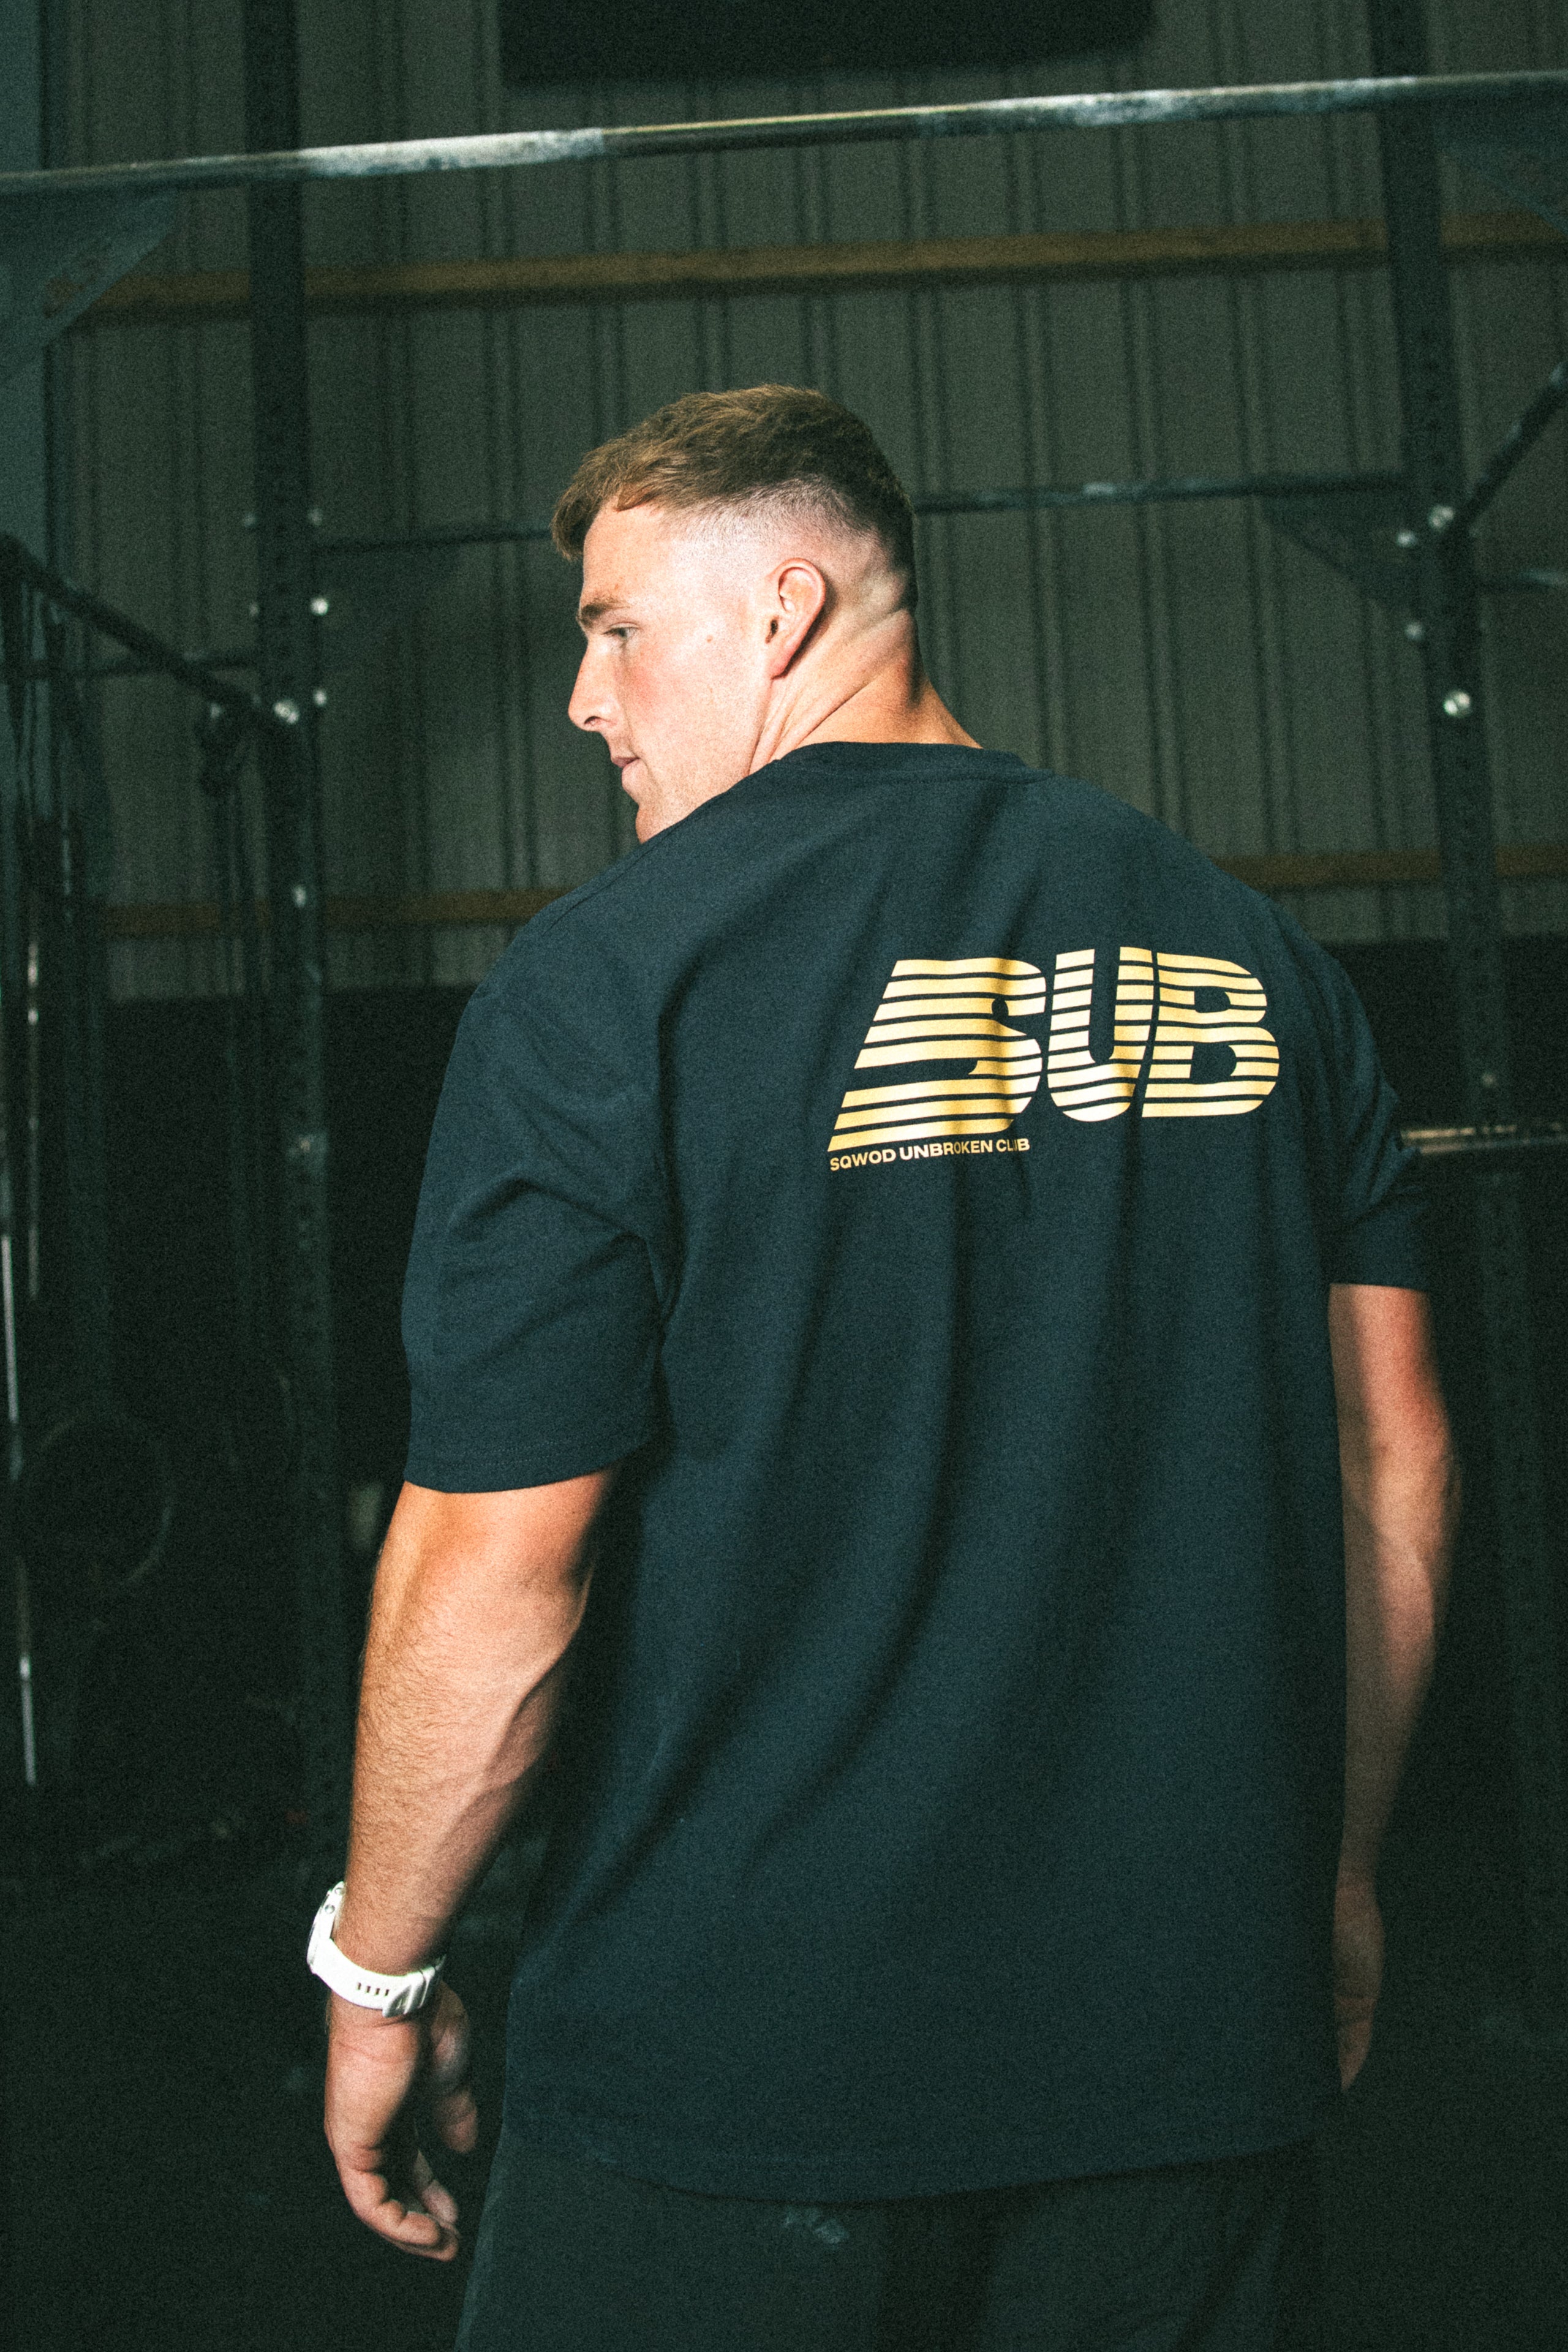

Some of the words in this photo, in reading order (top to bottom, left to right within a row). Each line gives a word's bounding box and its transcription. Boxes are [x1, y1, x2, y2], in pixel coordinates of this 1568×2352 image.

[827, 946, 1279, 1152] SUB
[830, 1149, 896, 1171] SQWOD
[899, 1140, 993, 1160] UNBROKEN
